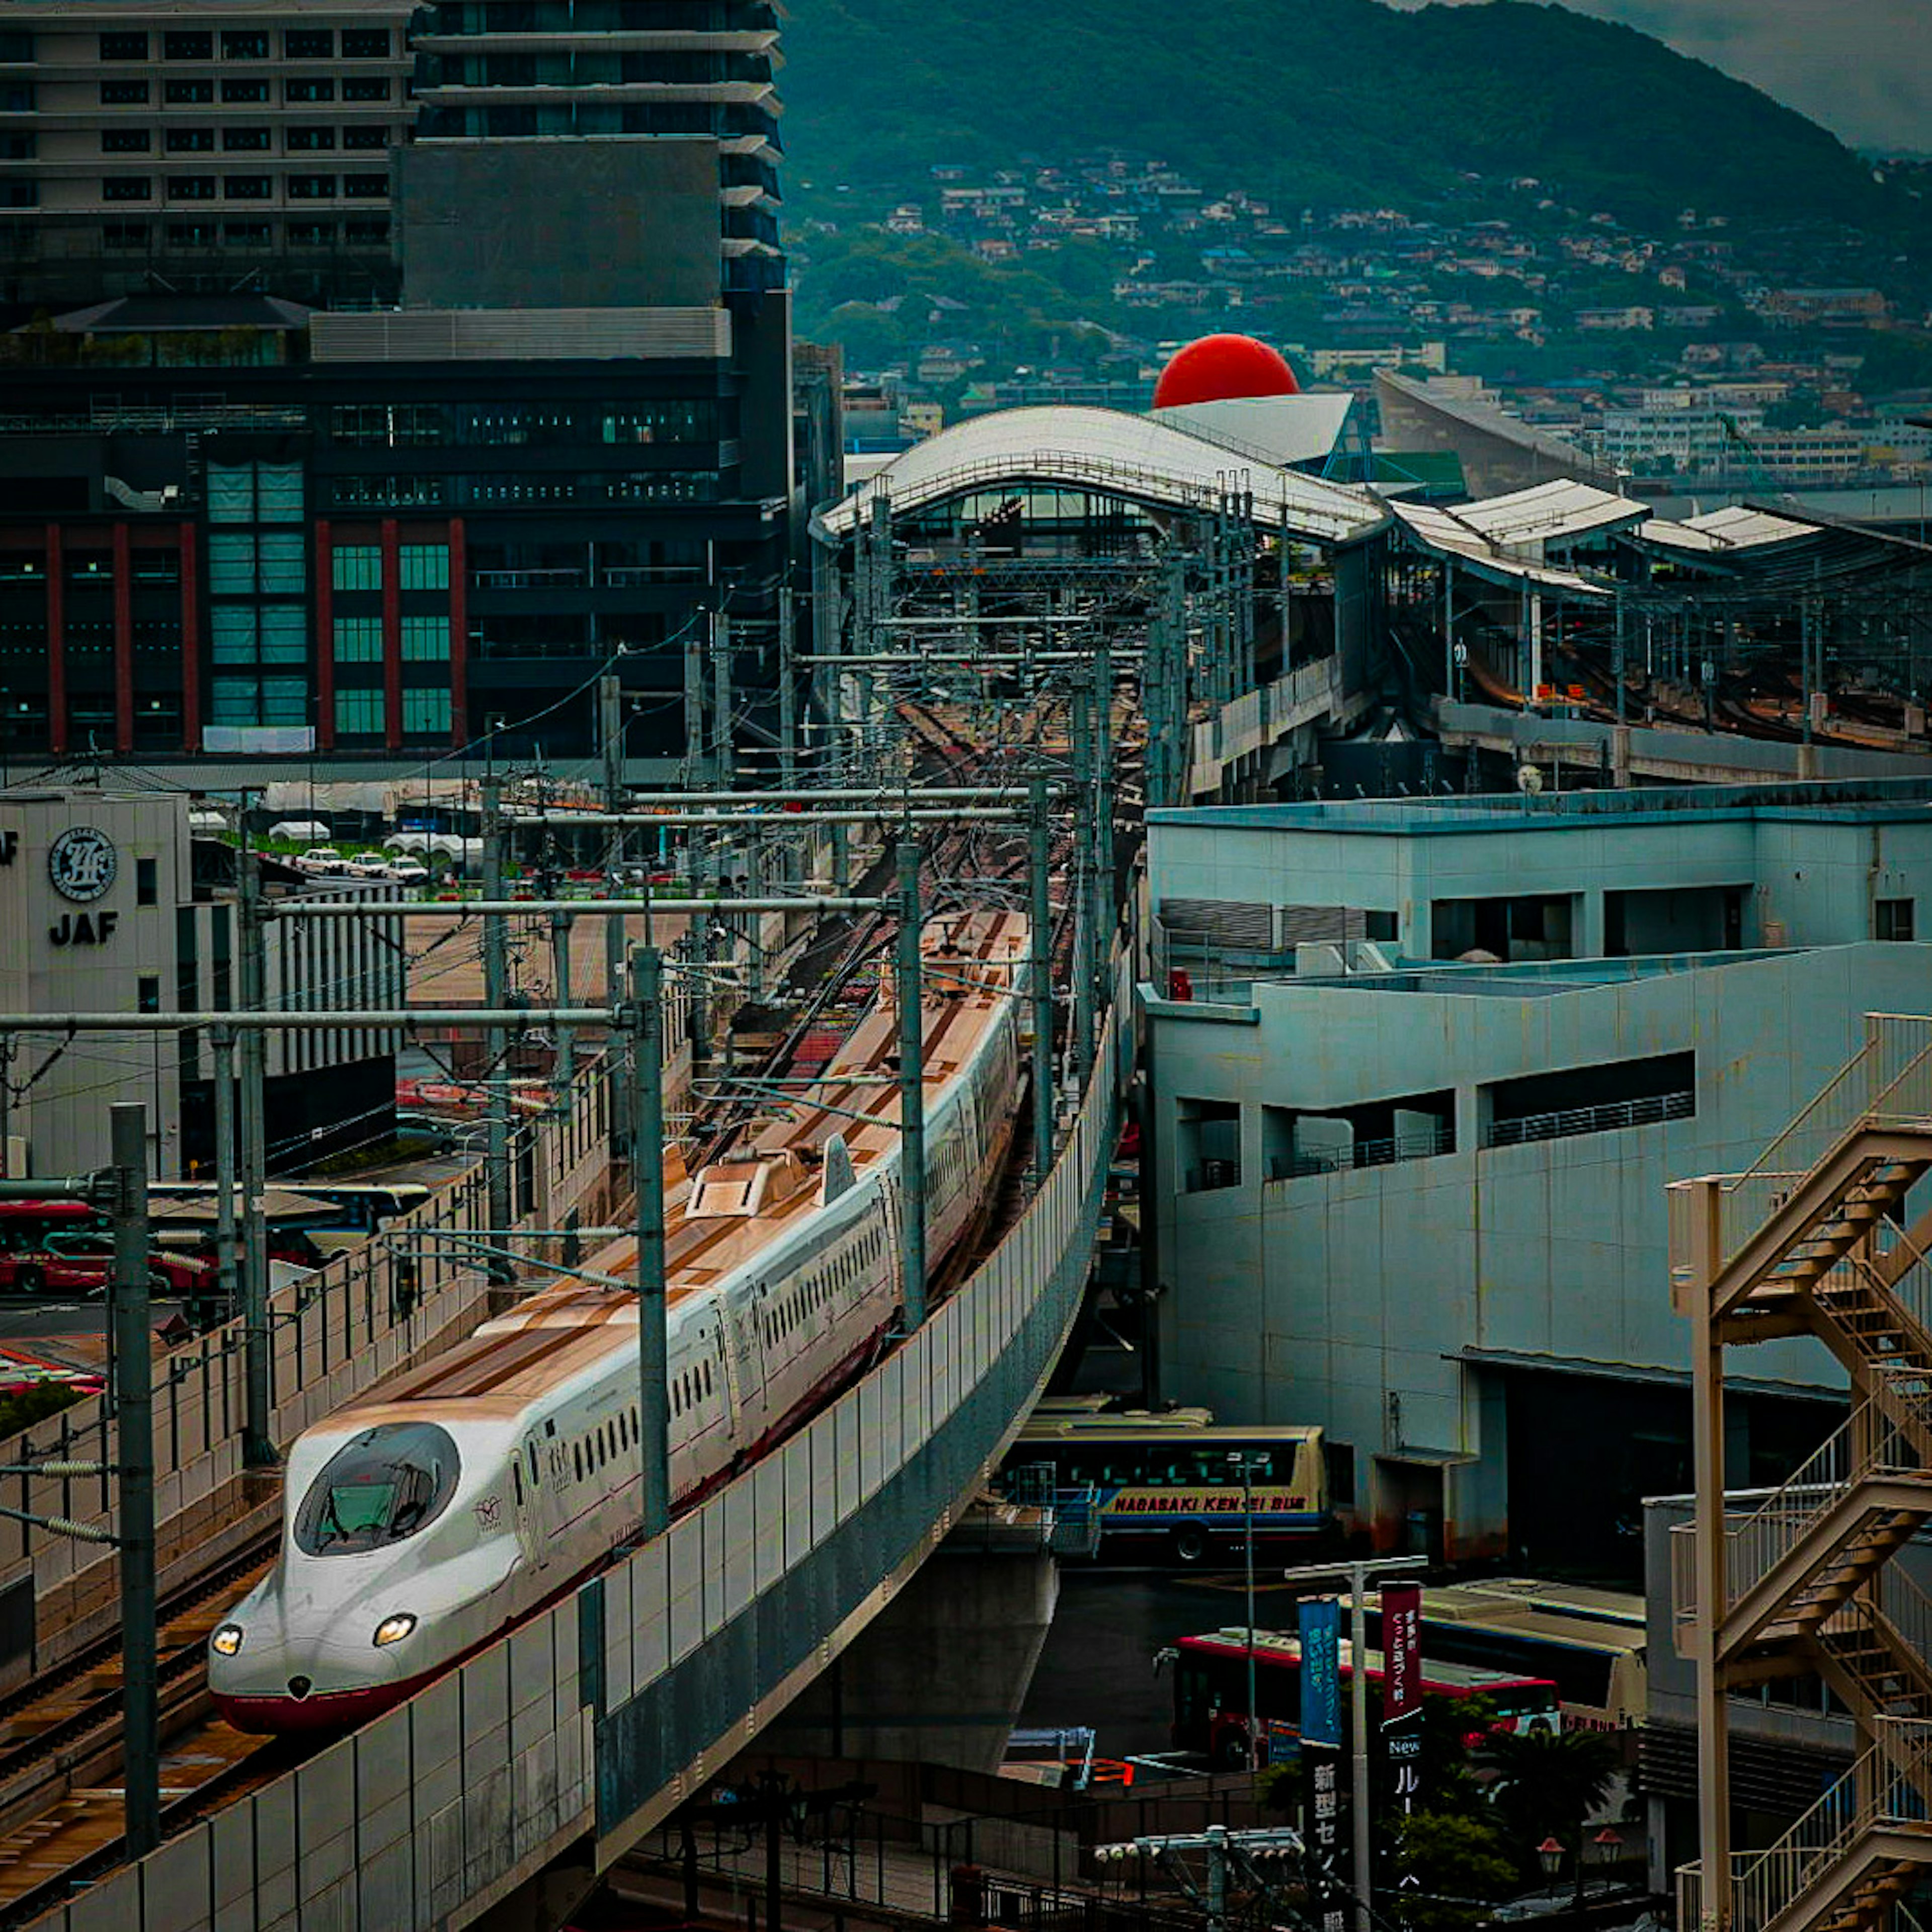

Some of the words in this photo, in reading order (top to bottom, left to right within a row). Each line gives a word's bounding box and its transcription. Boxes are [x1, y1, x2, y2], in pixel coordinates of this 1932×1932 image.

[50, 911, 117, 945] JAF
[1115, 1497, 1197, 1511] NAGASAKI
[1389, 1740, 1421, 1754] New
